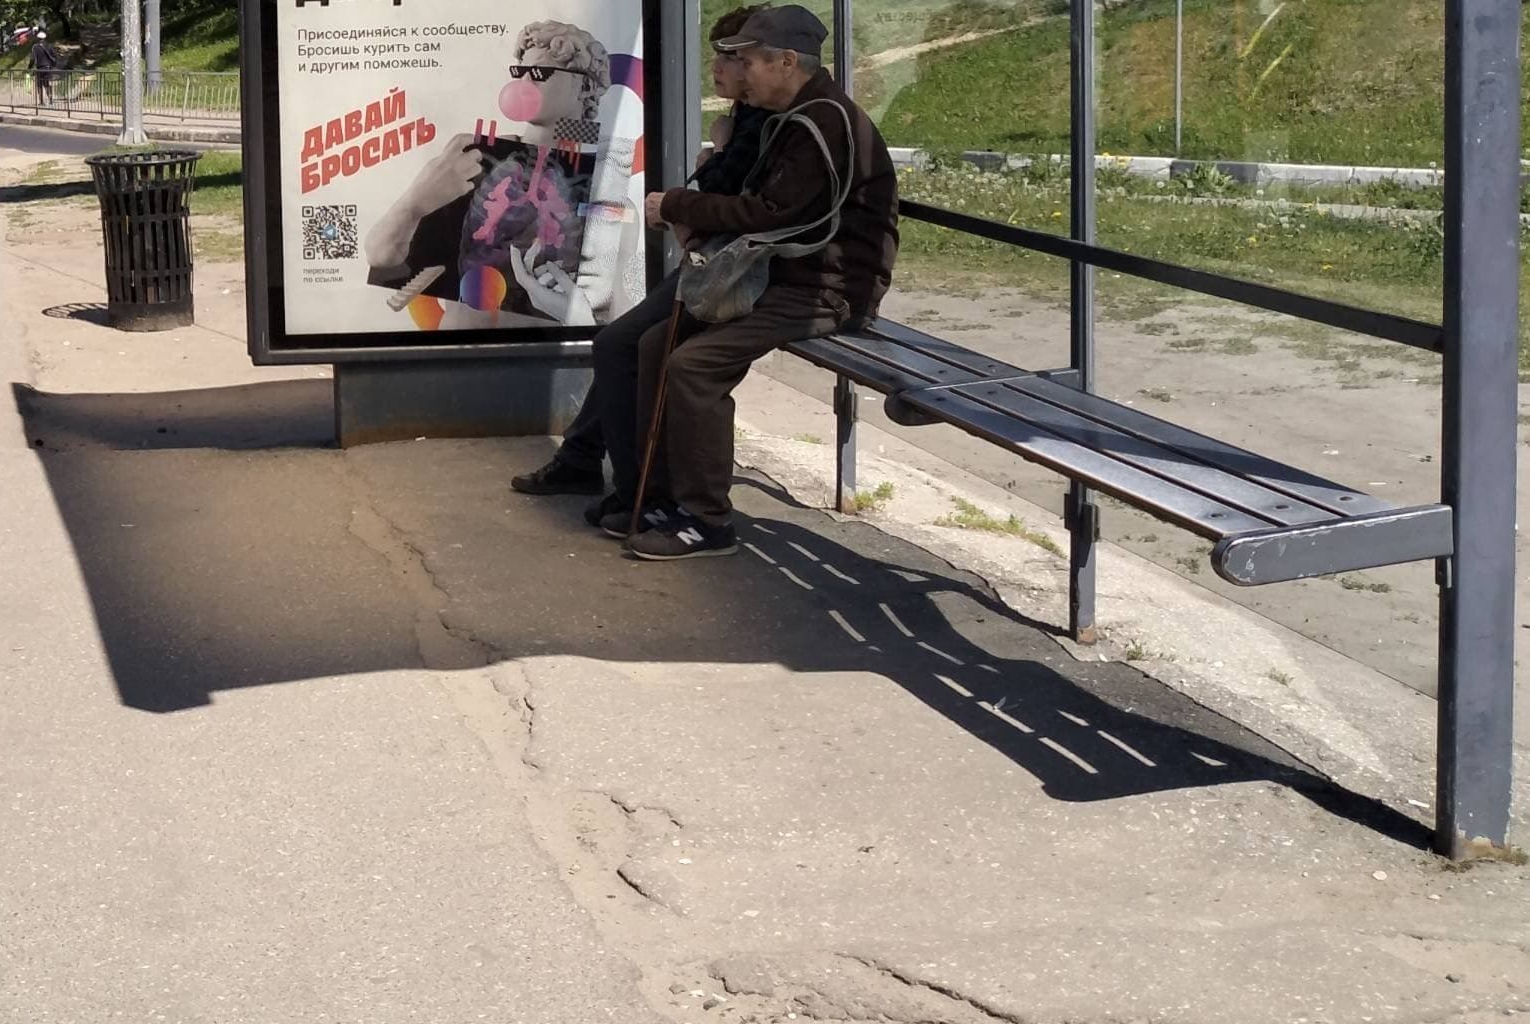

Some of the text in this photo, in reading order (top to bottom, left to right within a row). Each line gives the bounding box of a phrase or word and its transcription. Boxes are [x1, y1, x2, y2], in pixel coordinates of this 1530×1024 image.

[297, 23, 509, 43] Присоединяйся к сообществу.
[298, 41, 441, 59] Бросишь курить сам
[298, 57, 443, 74] и другим поможешь.
[301, 86, 406, 164] ДАВАЙ
[301, 117, 437, 194] БРОСАТЬ
